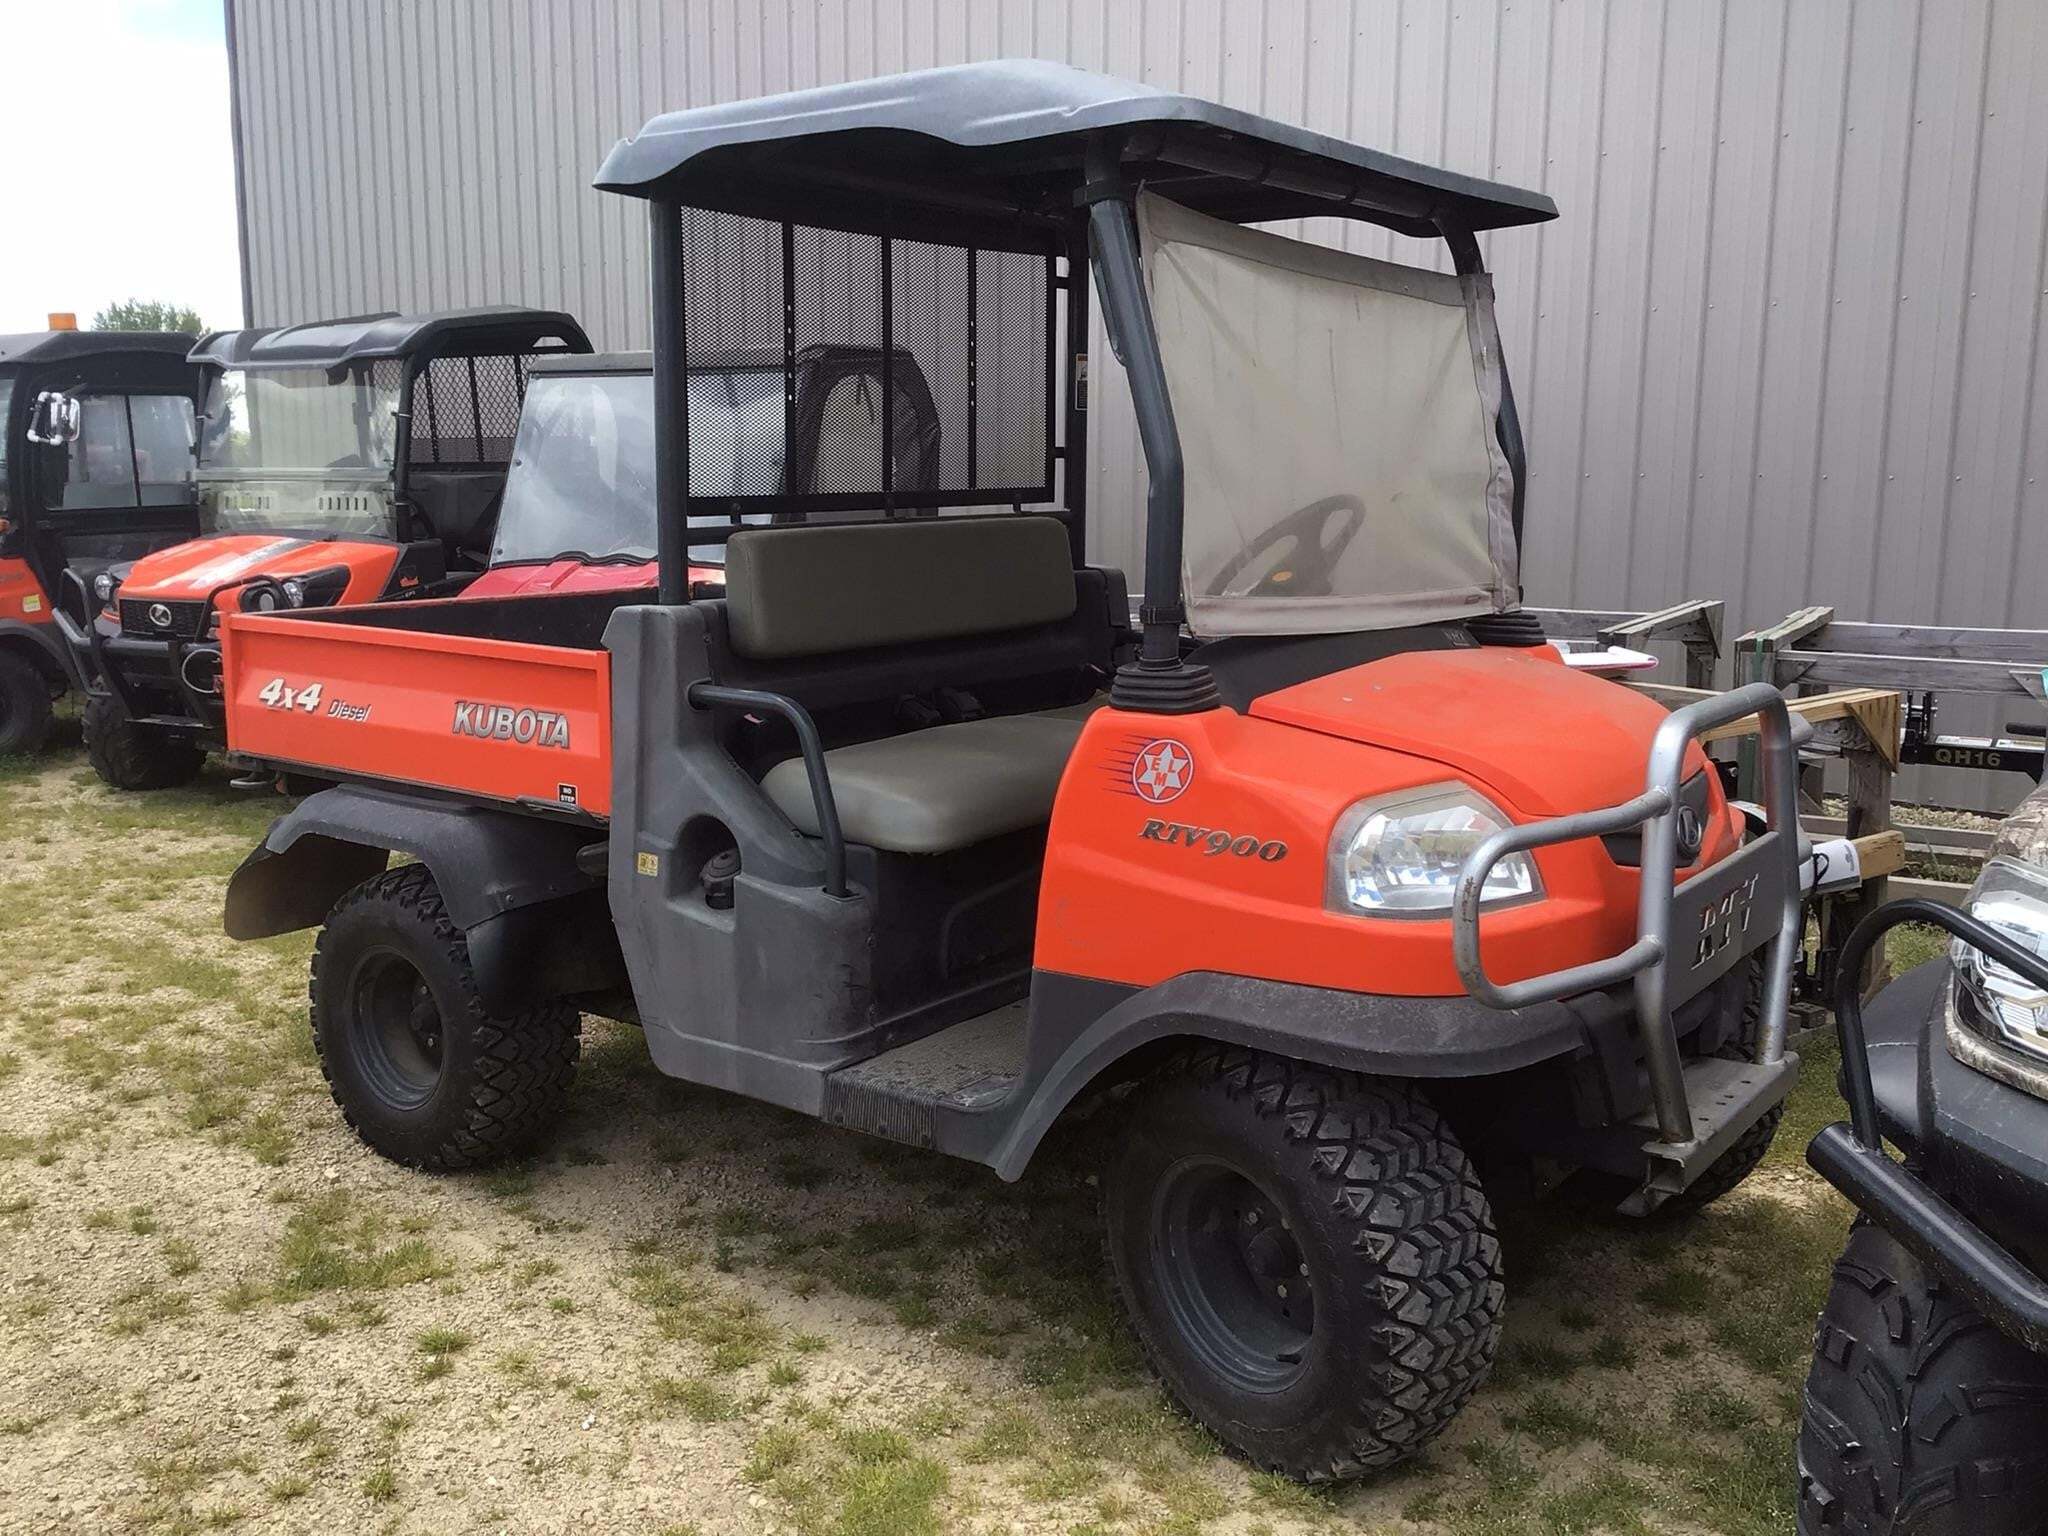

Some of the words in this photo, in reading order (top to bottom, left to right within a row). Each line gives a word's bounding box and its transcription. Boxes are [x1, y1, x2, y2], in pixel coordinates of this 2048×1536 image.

[259, 678, 322, 713] 4x4
[328, 699, 372, 722] Diesel
[453, 700, 570, 749] KUBOTA
[1935, 748, 2001, 767] QH16
[1137, 817, 1289, 863] RTV900
